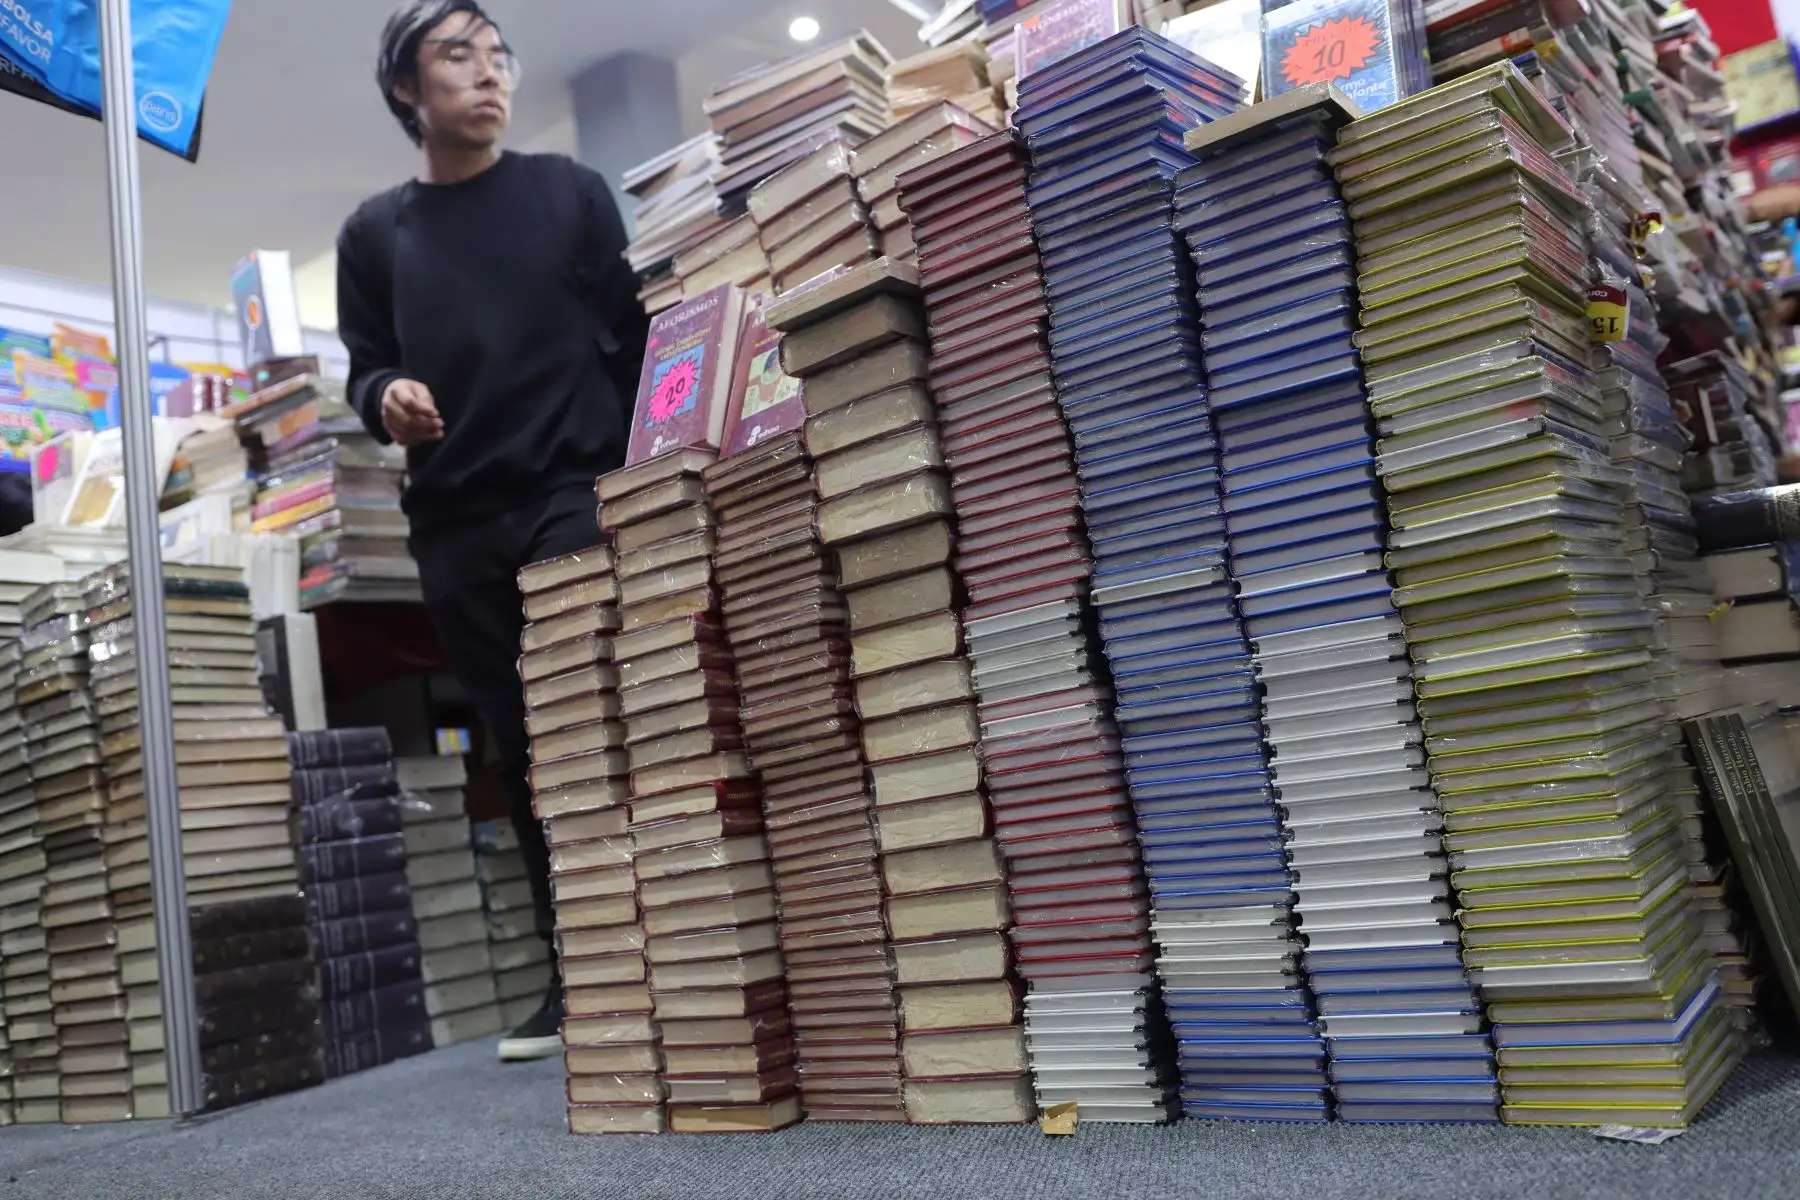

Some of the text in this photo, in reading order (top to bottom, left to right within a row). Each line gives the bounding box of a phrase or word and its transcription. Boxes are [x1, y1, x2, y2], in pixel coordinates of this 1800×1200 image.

[1310, 40, 1346, 75] 10
[656, 296, 719, 332] AFORISMOS
[1592, 316, 1620, 334] 15
[665, 377, 686, 408] 20
[1697, 738, 1715, 774] Hurtado
[1727, 732, 1744, 768] Hurtado
[1740, 730, 1757, 766] Hurtado
